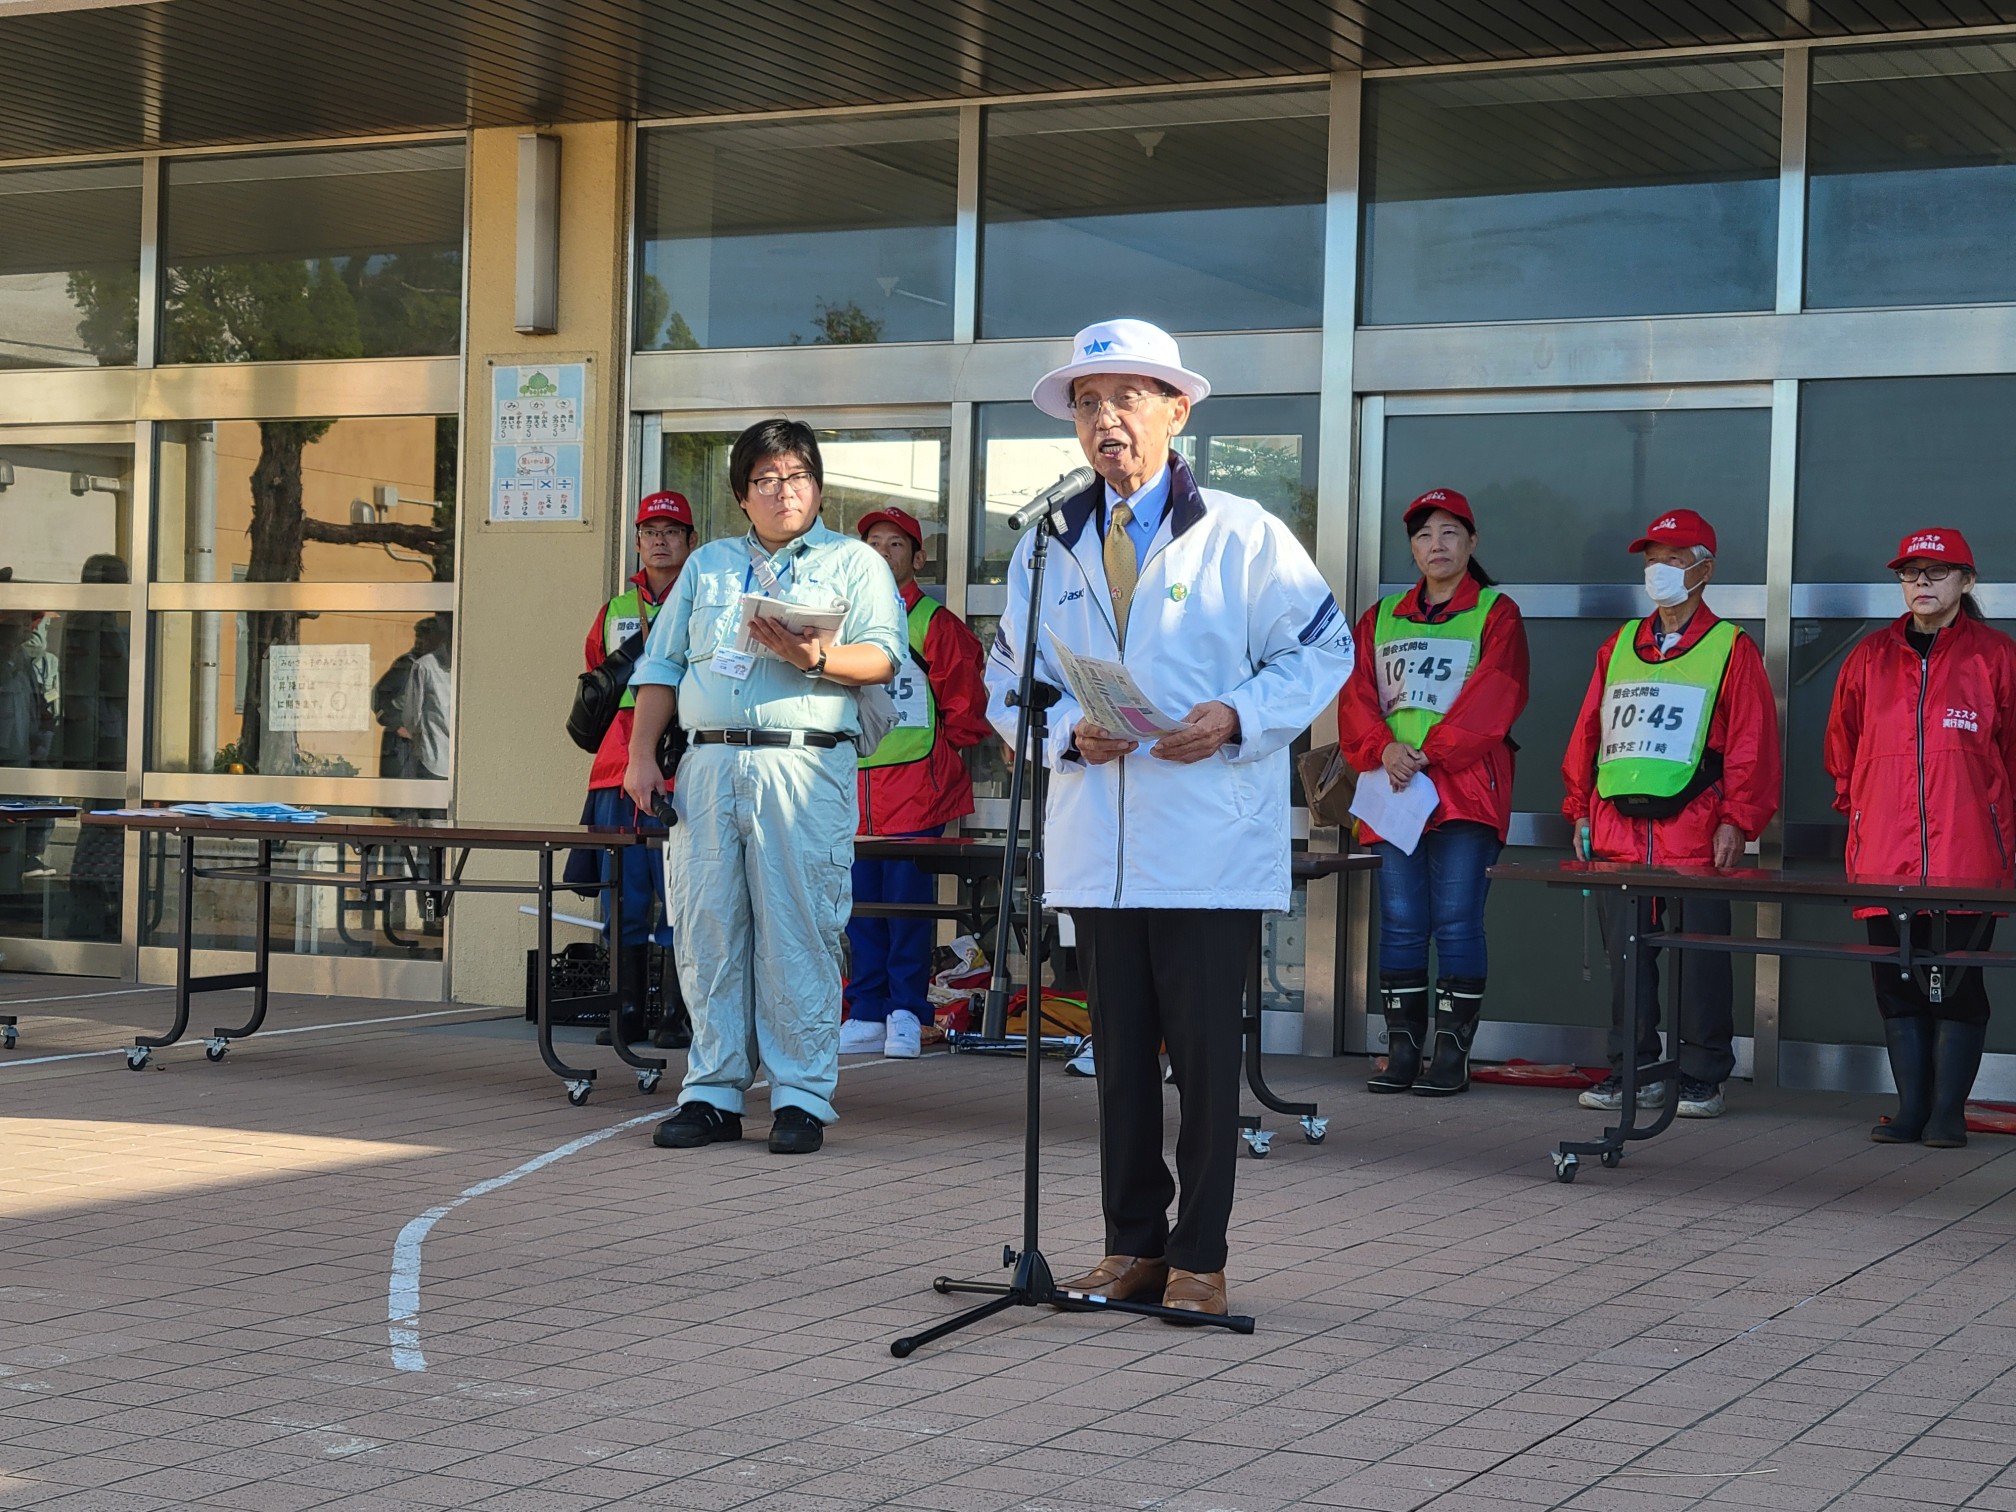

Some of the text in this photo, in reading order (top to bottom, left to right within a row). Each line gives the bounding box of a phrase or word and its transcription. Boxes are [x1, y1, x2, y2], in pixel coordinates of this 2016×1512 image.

[1385, 656, 1453, 686] 10:45
[884, 677, 914, 700] 45
[1612, 704, 1684, 730] 10:45
[1946, 707, 1978, 721] フェスタ
